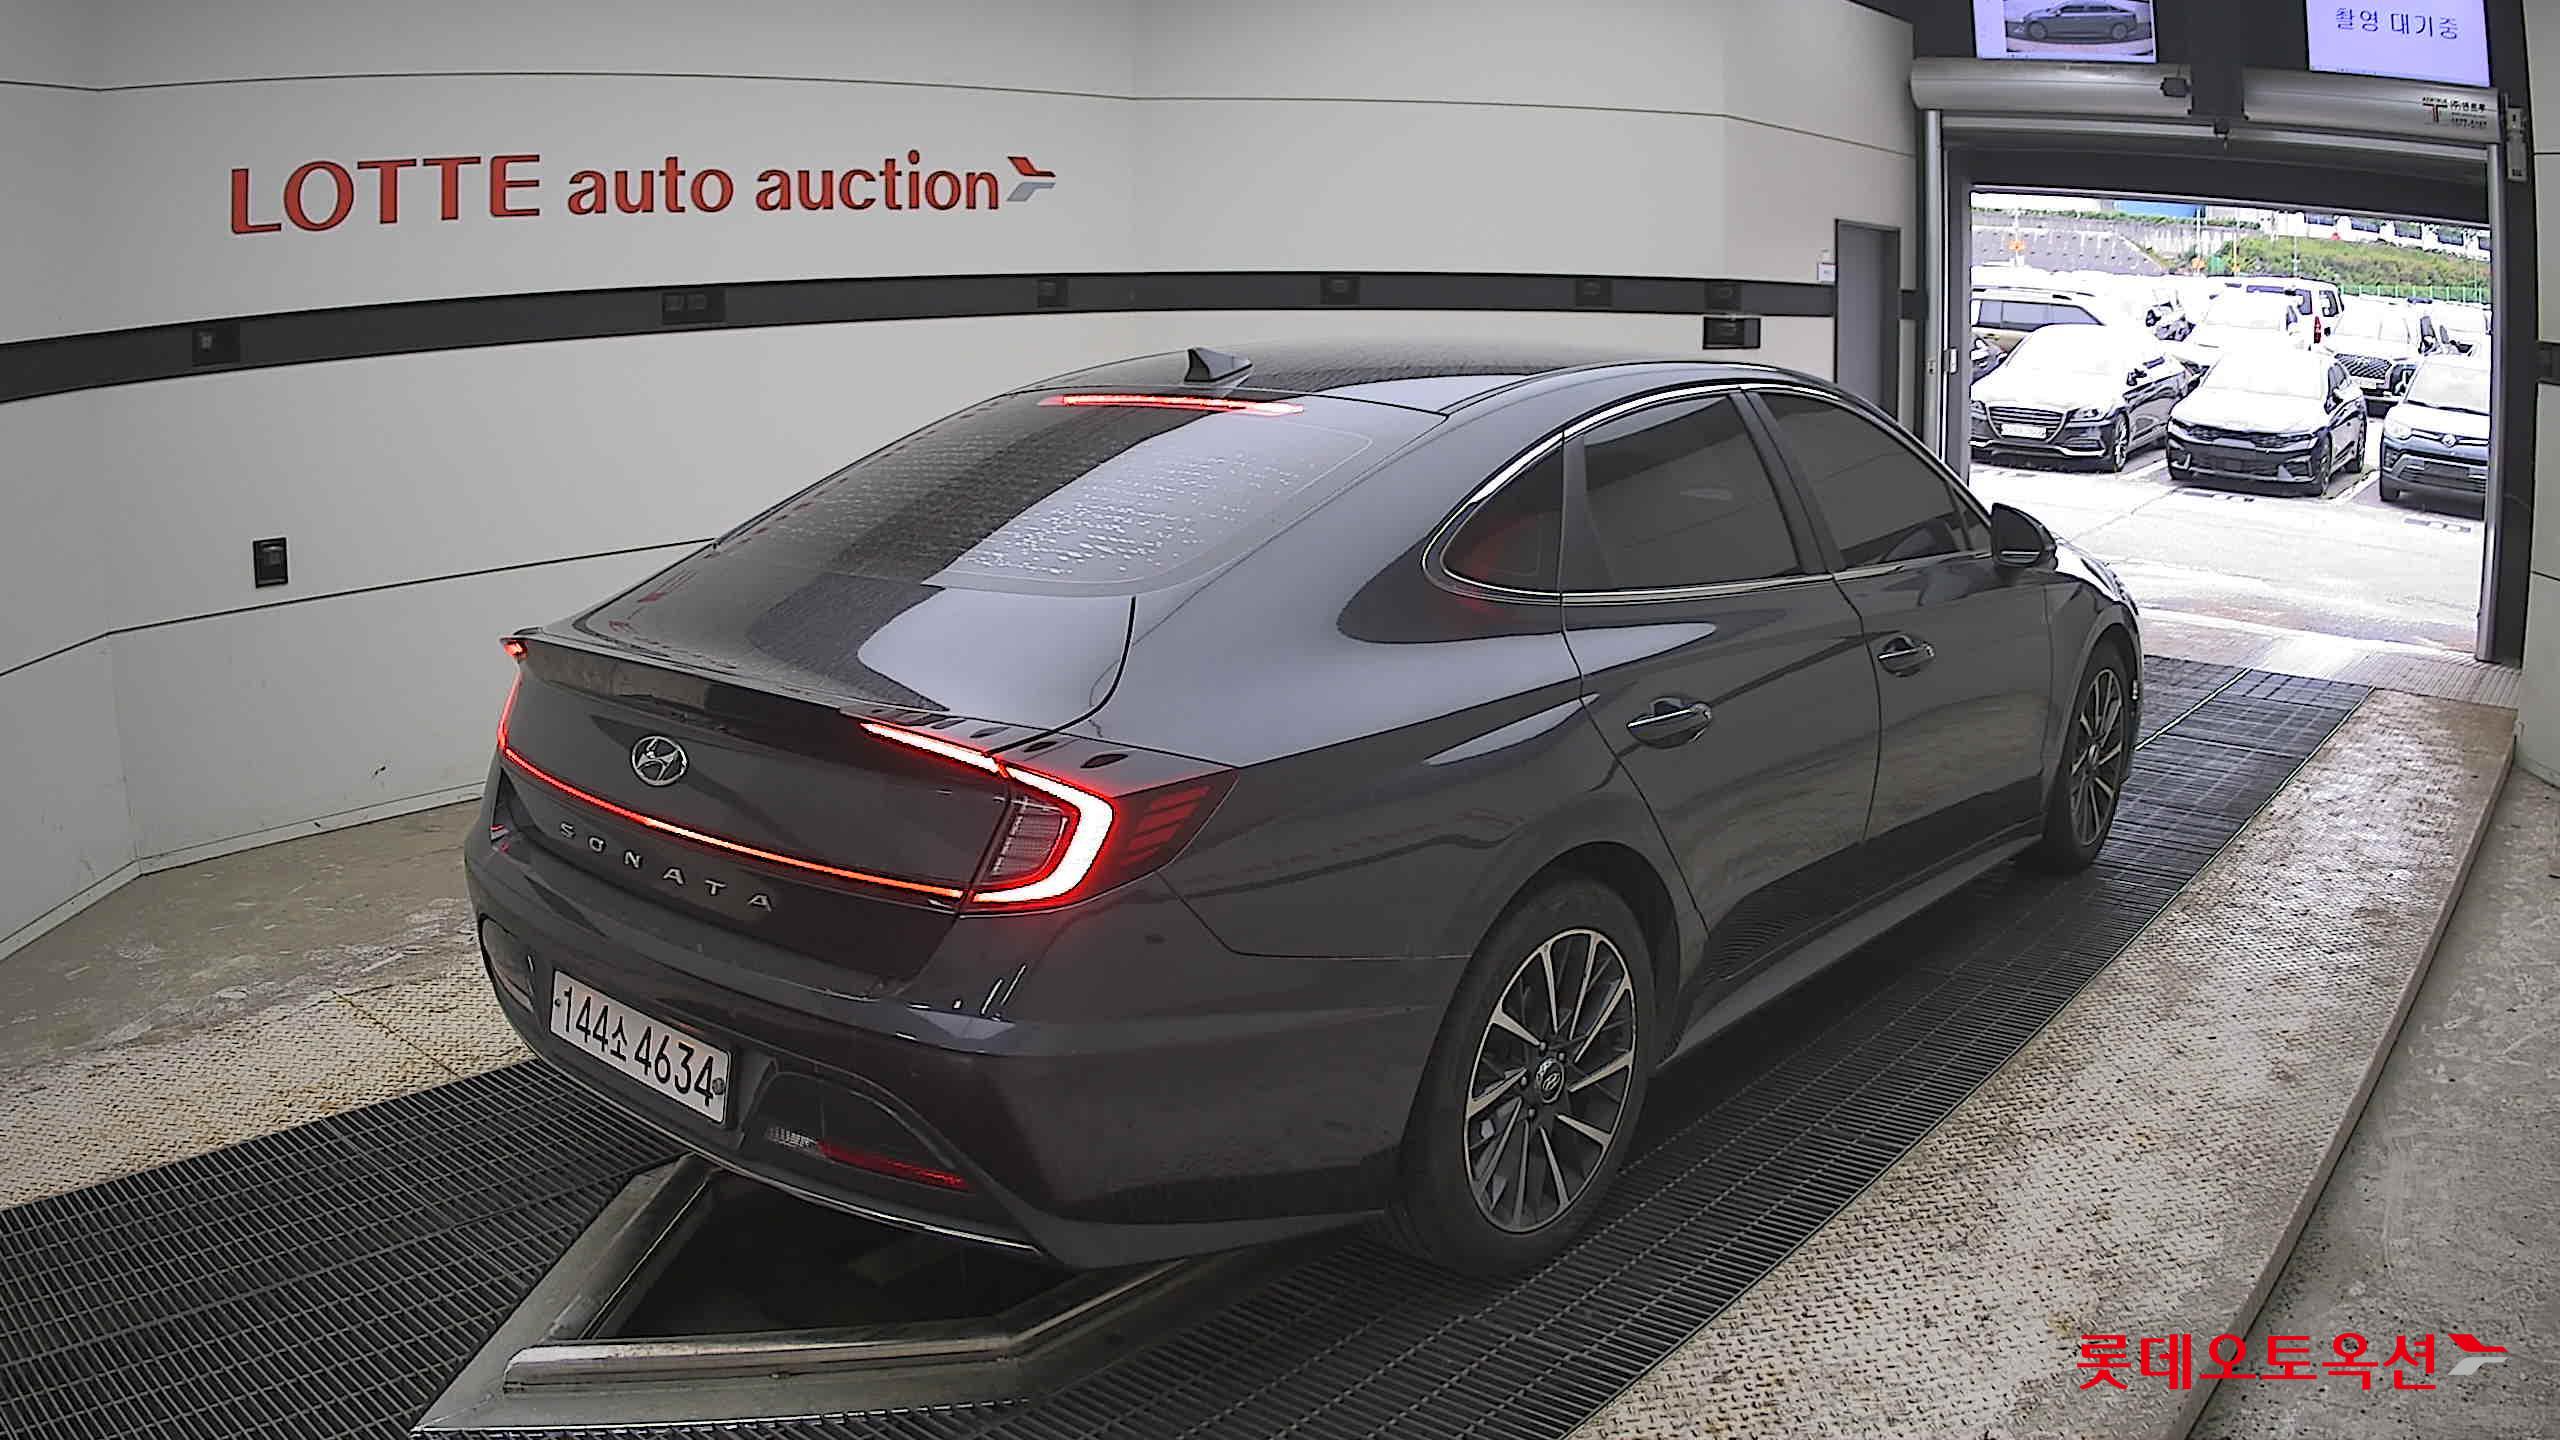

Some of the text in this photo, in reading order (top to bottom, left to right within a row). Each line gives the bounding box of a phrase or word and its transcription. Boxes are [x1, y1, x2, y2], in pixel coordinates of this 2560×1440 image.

[2336, 7, 2458, 40] 촬영 대기중
[231, 150, 1001, 234] LOTTE auto auction
[560, 822, 774, 913] SONATA
[564, 986, 715, 1107] 144소 4634
